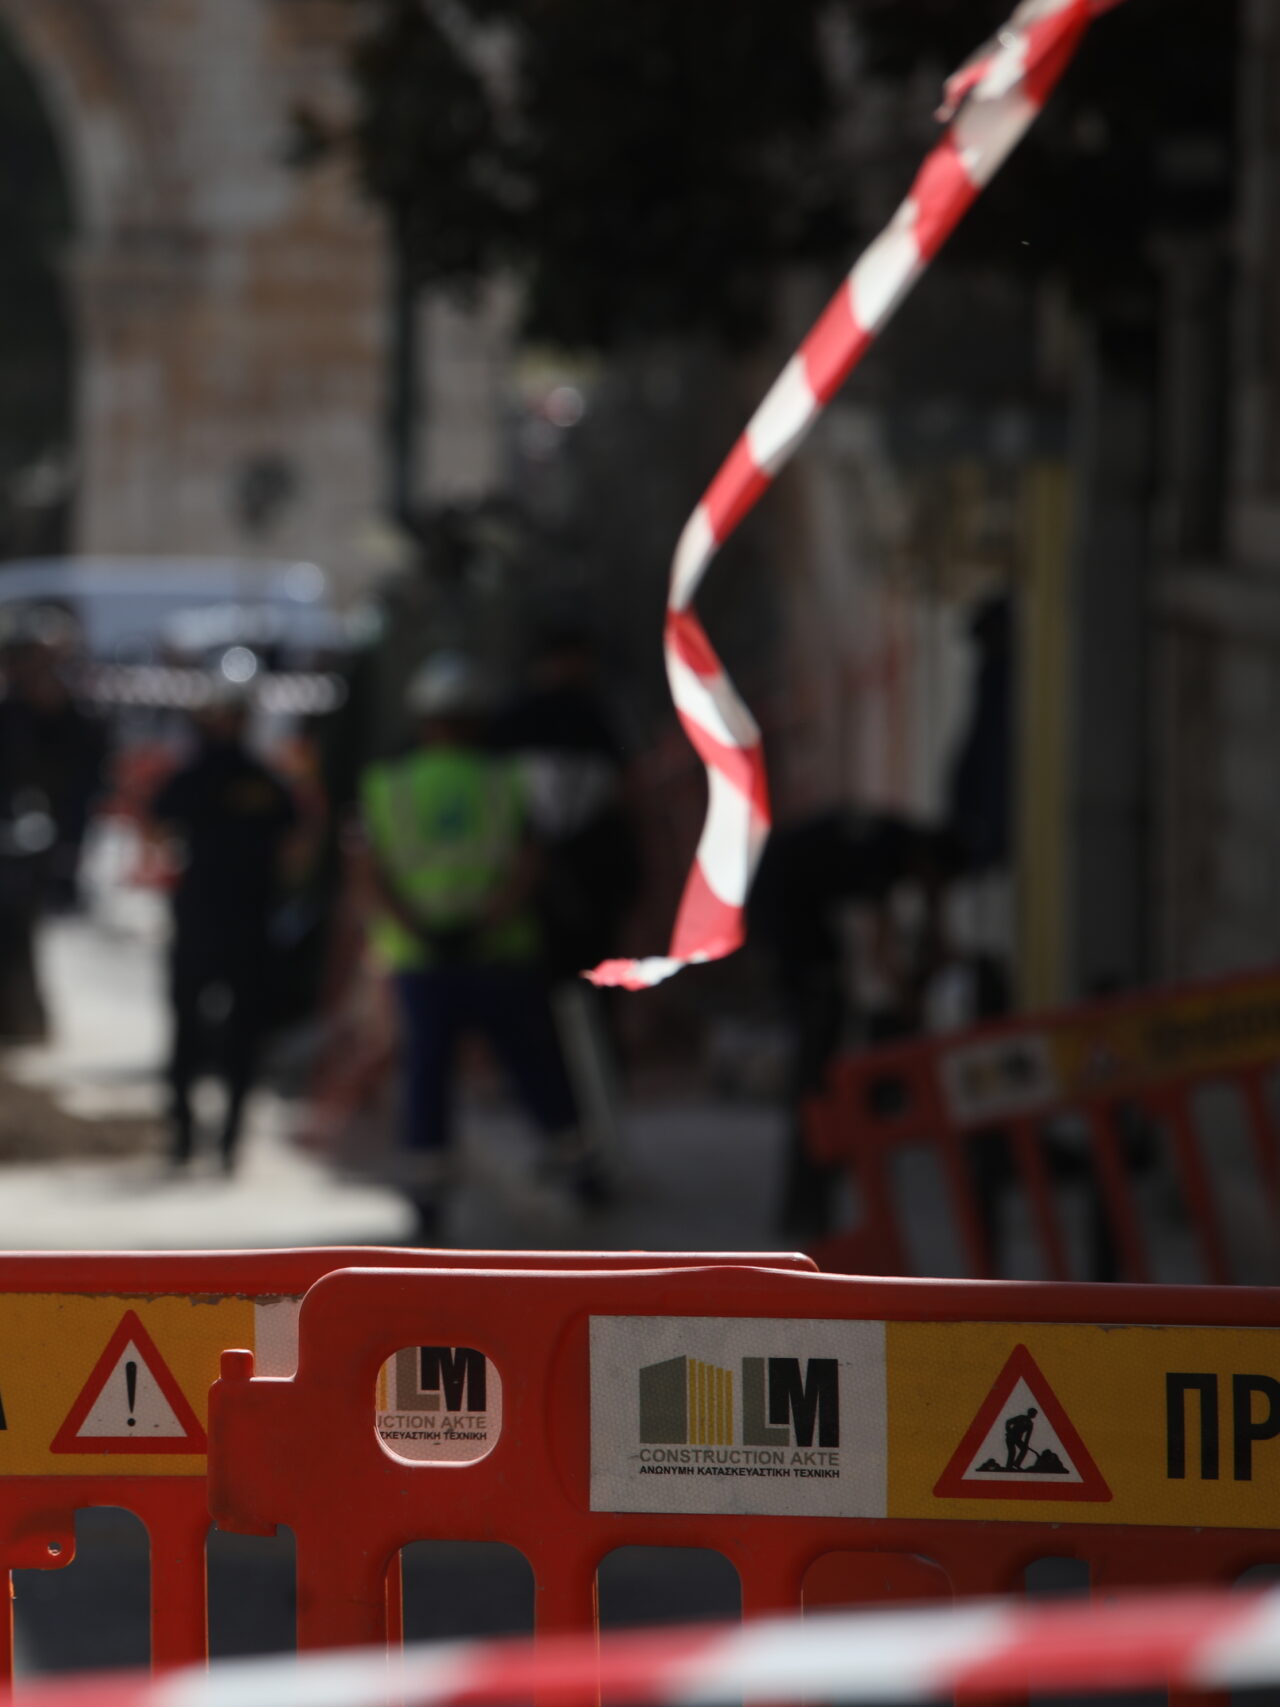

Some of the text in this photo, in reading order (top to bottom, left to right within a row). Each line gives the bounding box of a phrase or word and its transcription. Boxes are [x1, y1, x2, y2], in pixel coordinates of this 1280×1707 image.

[441, 1416, 487, 1429] AKTE
[639, 1449, 840, 1466] CONSTRUCTION AKTE
[640, 1465, 695, 1475] ΑΝΩΝΥΜΗ
